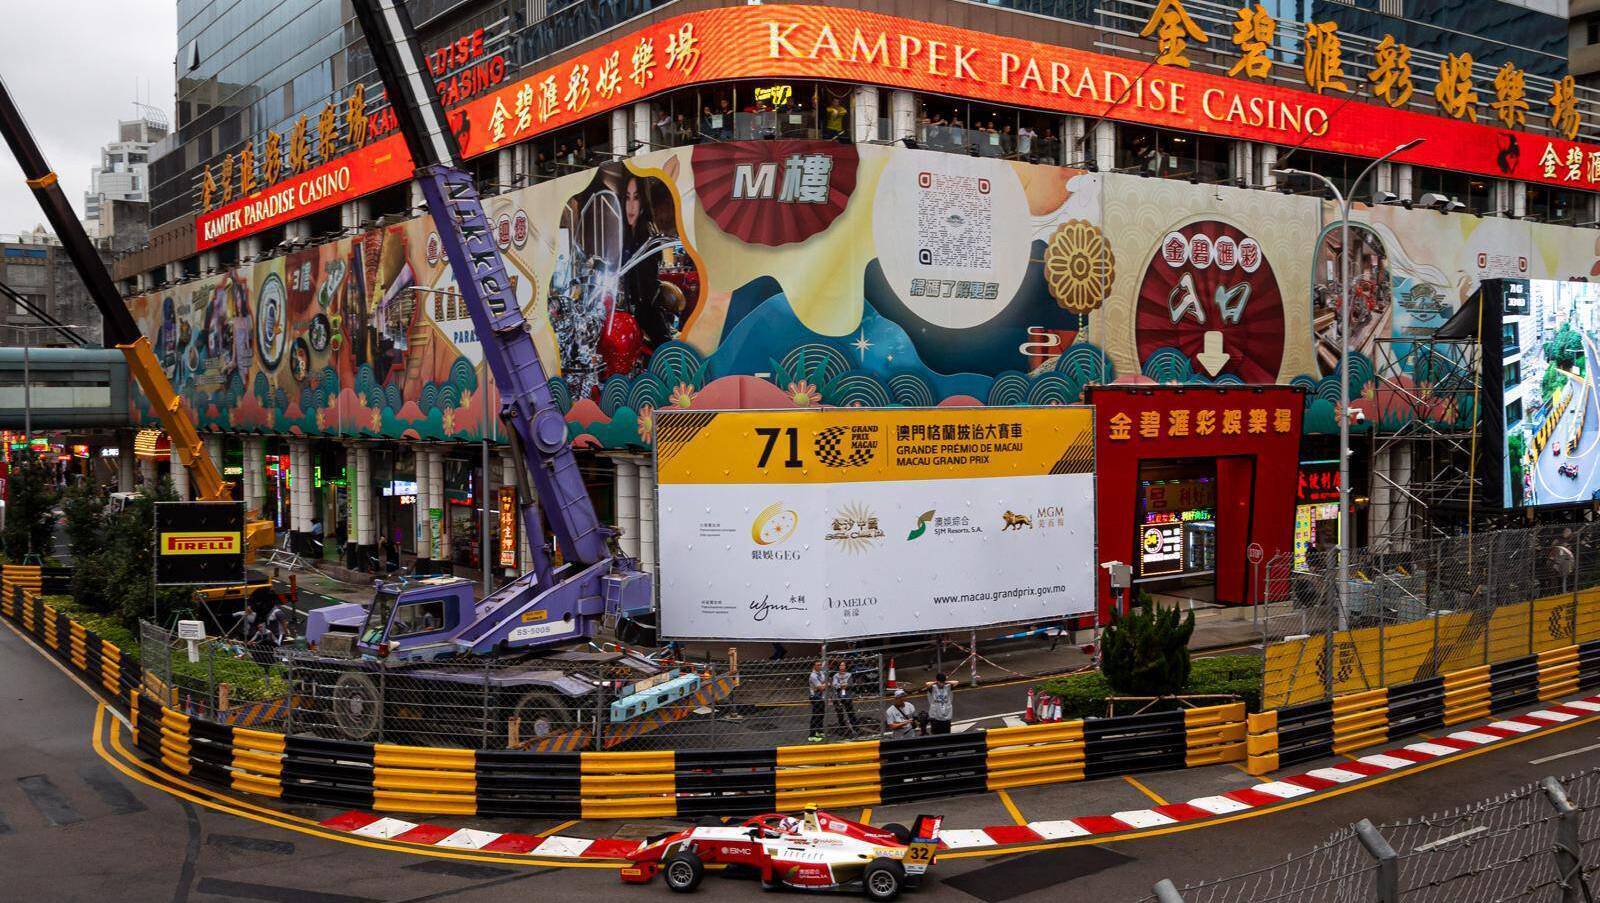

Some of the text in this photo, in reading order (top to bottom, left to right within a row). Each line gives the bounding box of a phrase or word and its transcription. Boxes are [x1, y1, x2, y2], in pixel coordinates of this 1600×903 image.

[766, 22, 1329, 137] KAMPEK PARADISE CASINO
[204, 166, 350, 241] KAMPEK PARADISE CASINO
[896, 423, 1023, 441] 澳門格蘭披治大賽車
[754, 427, 803, 468] 71
[896, 444, 938, 455] GRANDE
[980, 443, 992, 453] DE
[994, 442, 1023, 452] MACAU
[896, 455, 990, 466] MACAU GRAND PRIX
[1037, 507, 1064, 518] MGM
[168, 536, 235, 550] PIRELLI
[933, 584, 1066, 604] www.macau.grandprix.gov.mo
[911, 848, 929, 860] 32
